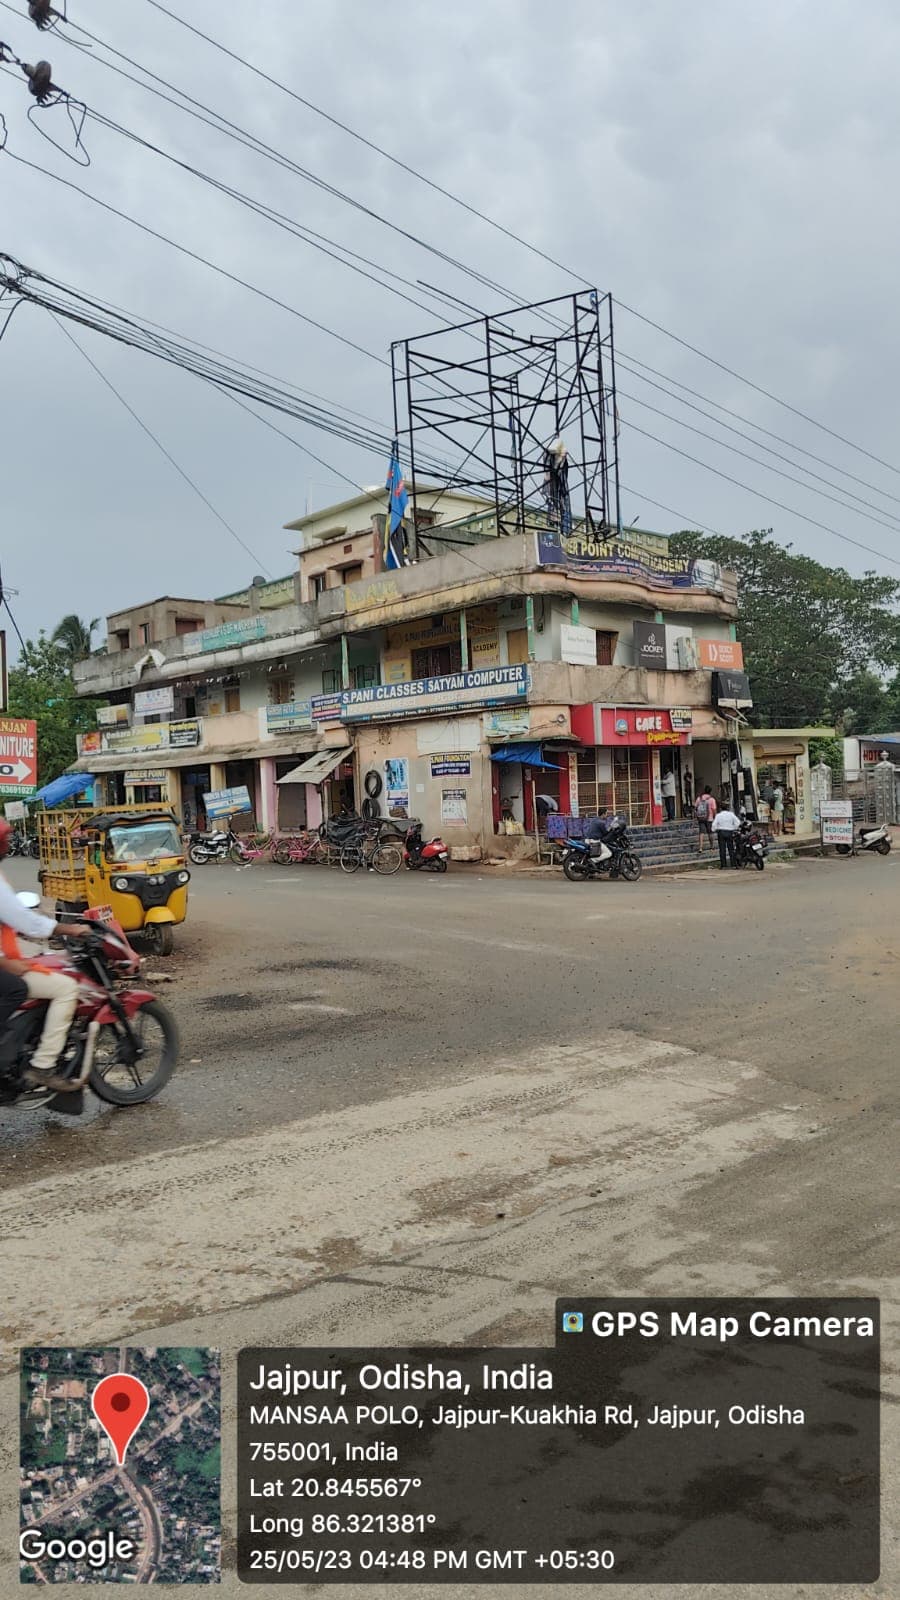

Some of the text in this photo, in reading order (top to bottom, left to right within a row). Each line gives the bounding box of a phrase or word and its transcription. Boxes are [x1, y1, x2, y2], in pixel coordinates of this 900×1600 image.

[581, 542, 614, 558] POINT
[641, 644, 664, 653] JOCKEY
[343, 690, 373, 704] S.PANI
[376, 682, 424, 699] CLASSES
[428, 675, 465, 693] SATYAM
[467, 667, 523, 687] COMPUTER
[0, 722, 27, 733] NJAN
[636, 716, 661, 731] CAKE
[569, 755, 577, 800] XEROX
[825, 826, 852, 834] MEDICINE
